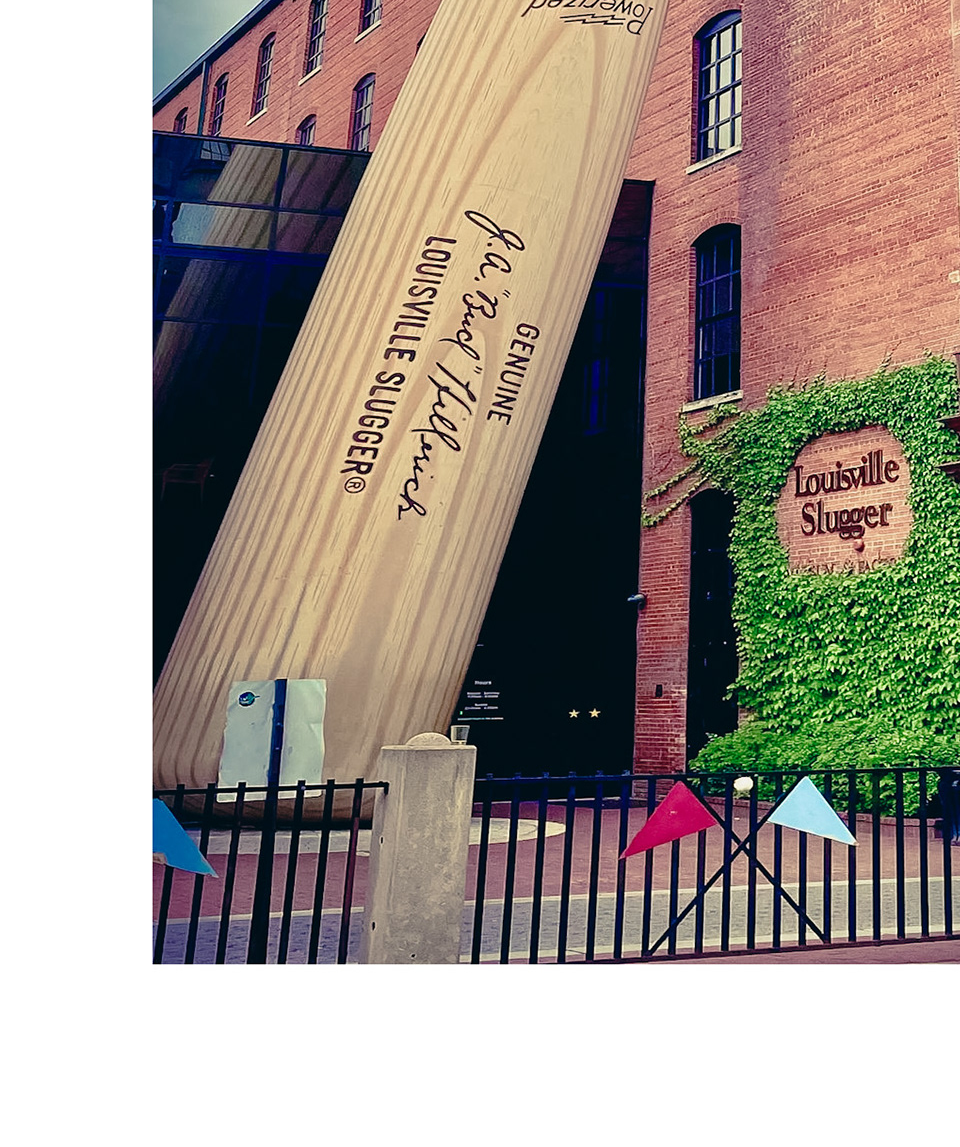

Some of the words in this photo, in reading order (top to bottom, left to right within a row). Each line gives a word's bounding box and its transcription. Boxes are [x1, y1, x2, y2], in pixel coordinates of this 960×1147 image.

[383, 235, 457, 363] LOUISVILLE
[486, 322, 541, 426] GENUINE
[794, 449, 900, 499] Louisville
[800, 499, 894, 540] Slugger
